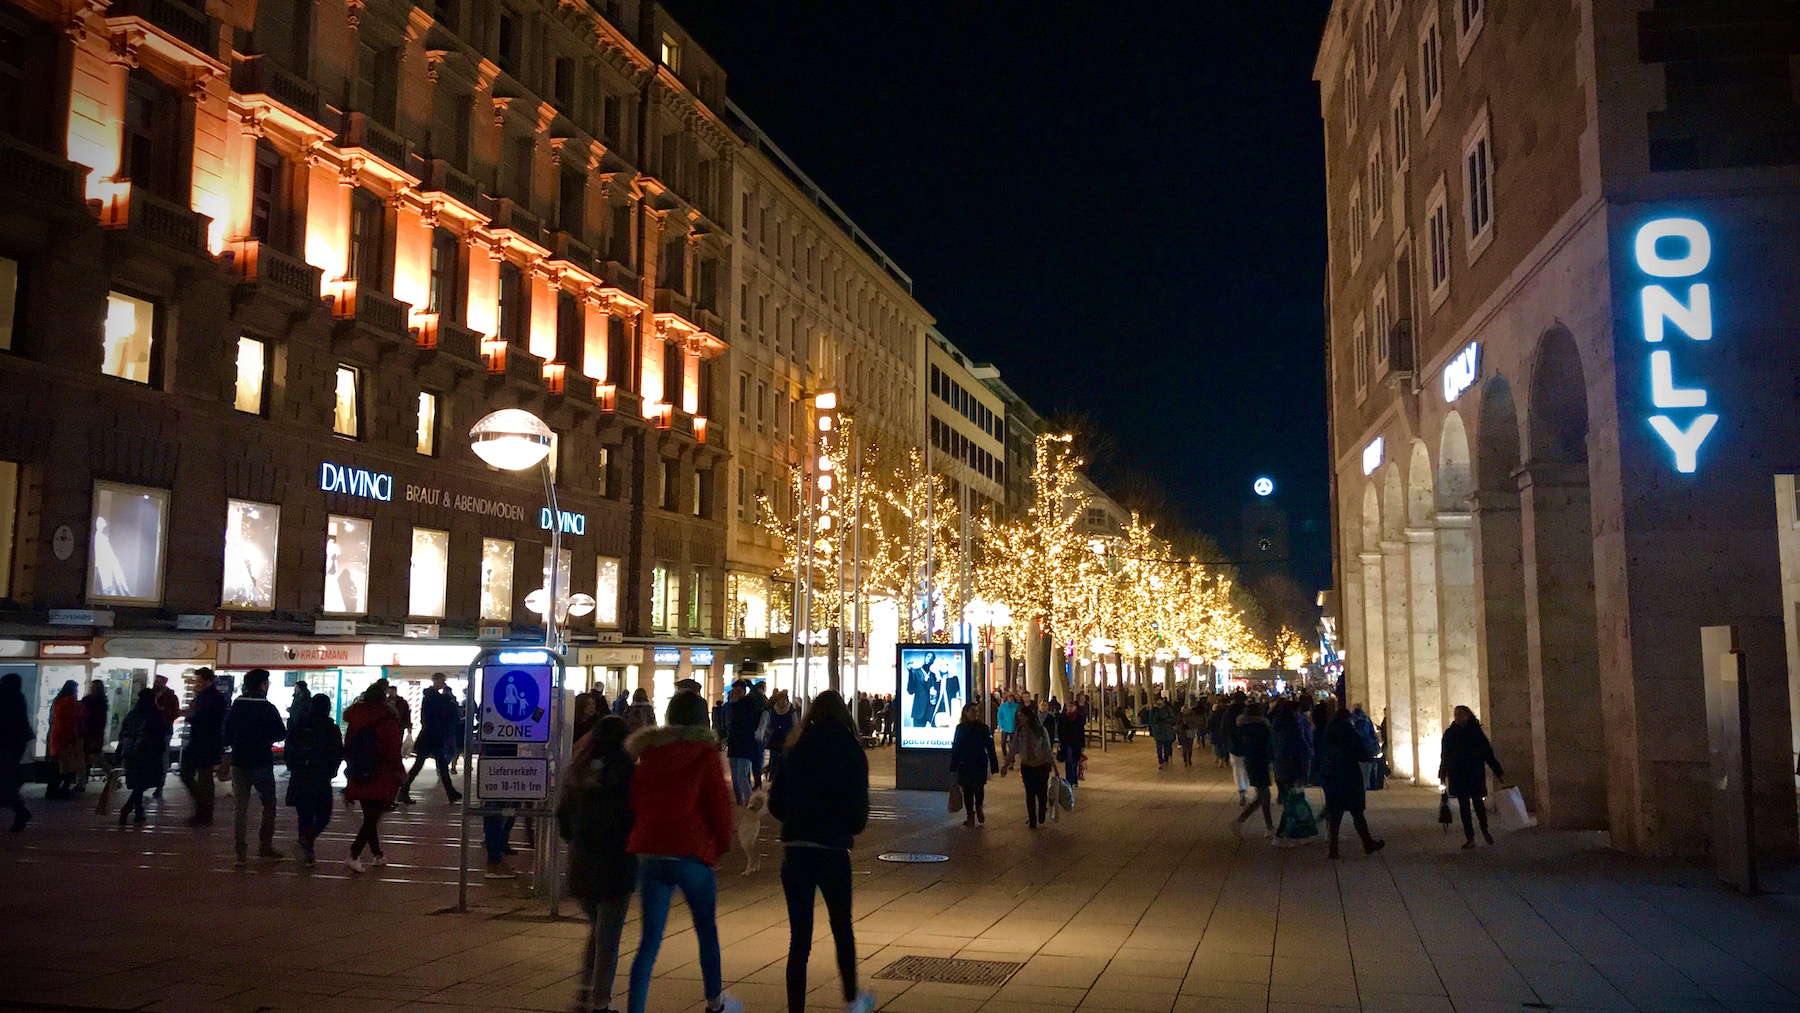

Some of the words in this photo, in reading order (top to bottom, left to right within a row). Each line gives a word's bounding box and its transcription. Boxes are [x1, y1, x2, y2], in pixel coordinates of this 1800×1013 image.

[1635, 217, 1719, 473] ONLY
[406, 484, 440, 506] BRAUT
[442, 493, 451, 507] &
[453, 494, 525, 521] ABENDMODEN
[300, 649, 349, 661] KRATZMANN
[497, 725, 532, 738] ZONE
[488, 766, 538, 776] Lieferverkehr
[484, 783, 498, 791] von
